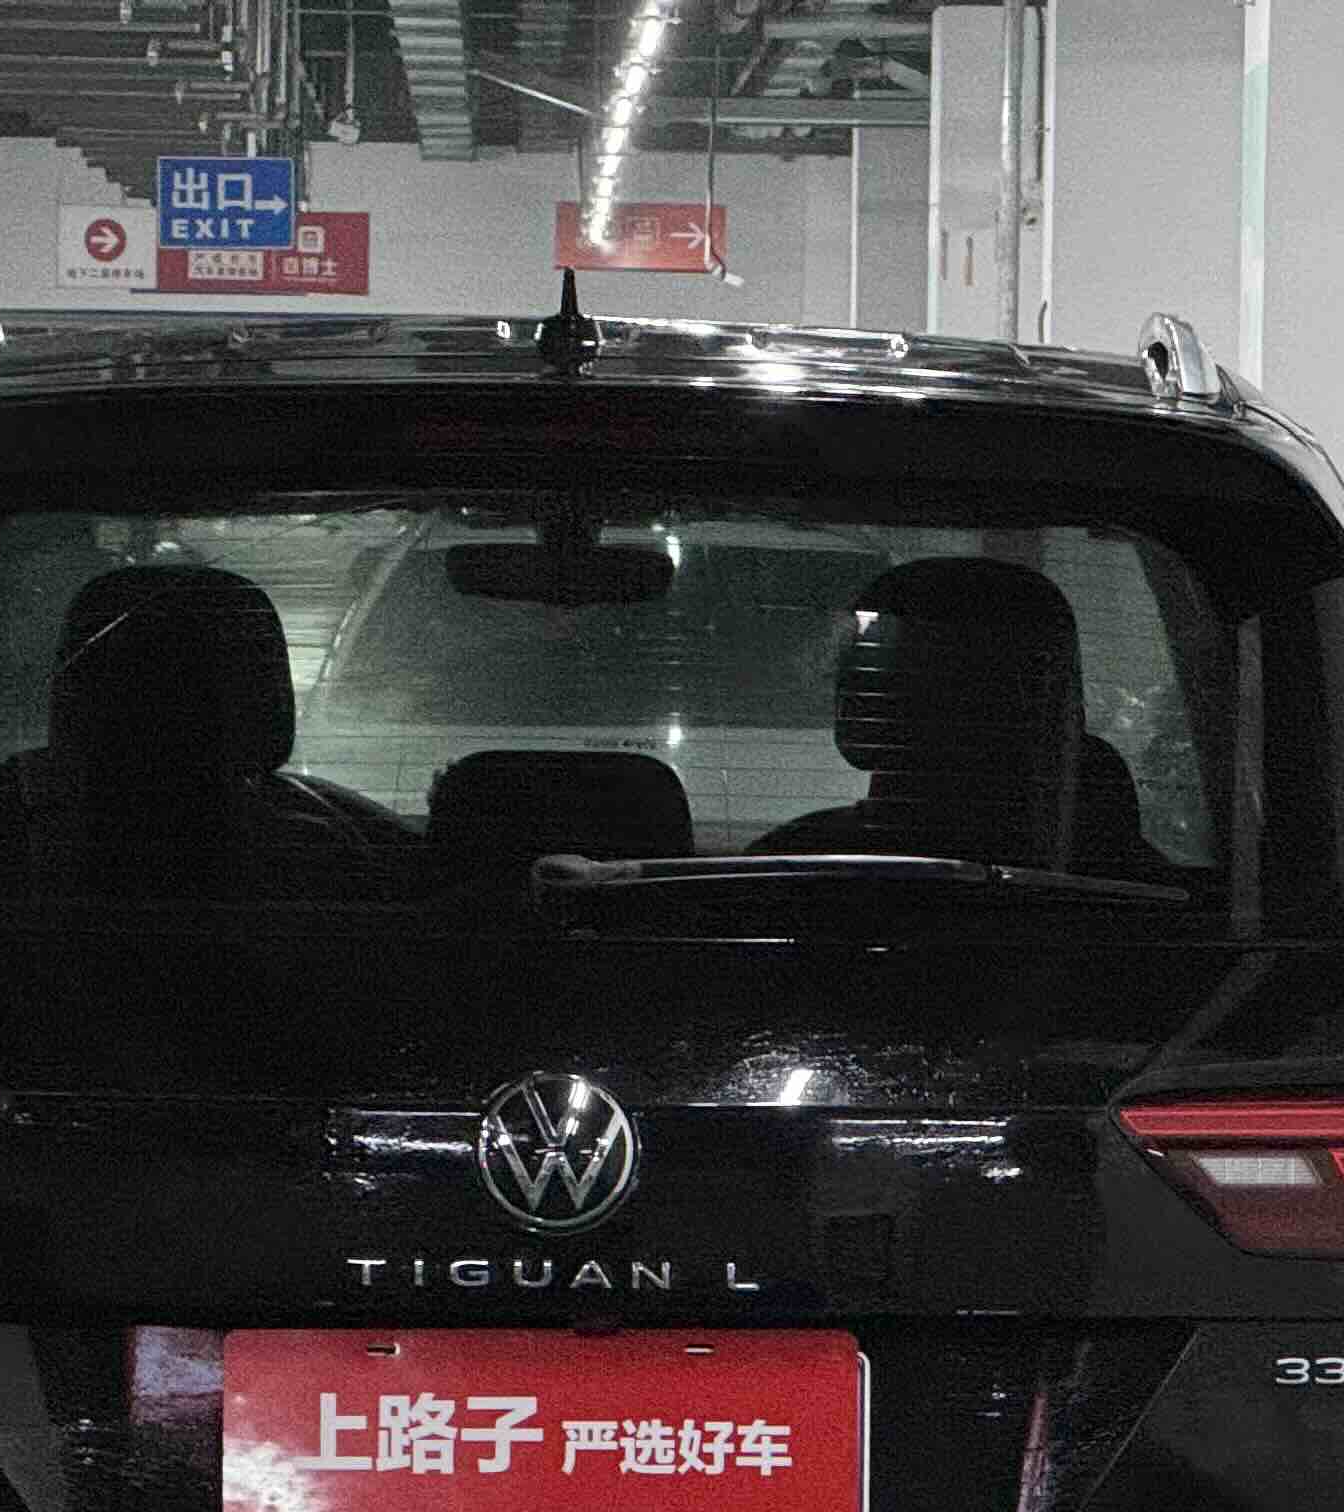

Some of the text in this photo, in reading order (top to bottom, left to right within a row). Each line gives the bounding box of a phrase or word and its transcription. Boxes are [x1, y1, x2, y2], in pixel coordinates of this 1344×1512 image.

[171, 167, 254, 211] 出口
[171, 218, 255, 240] EXIT
[347, 1258, 760, 1291] TIGUAN L
[297, 1392, 793, 1476] 上路子 严选好车
